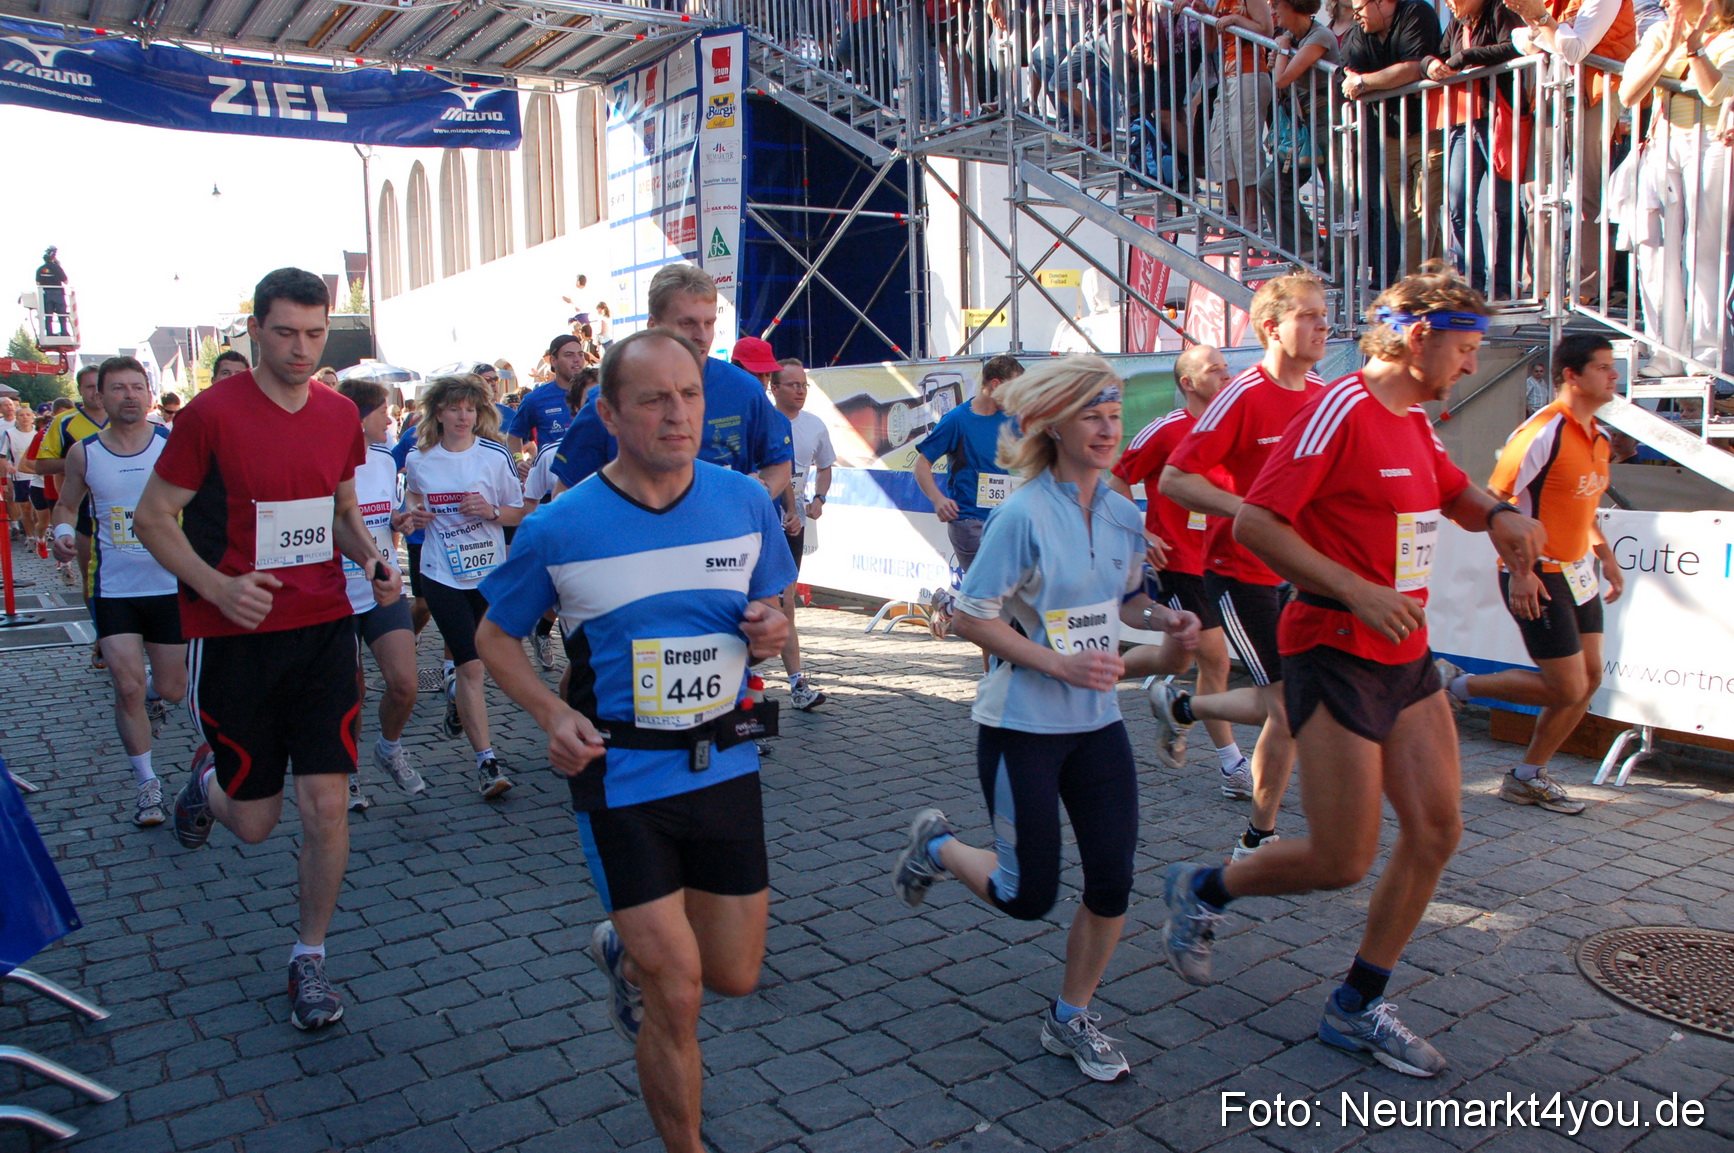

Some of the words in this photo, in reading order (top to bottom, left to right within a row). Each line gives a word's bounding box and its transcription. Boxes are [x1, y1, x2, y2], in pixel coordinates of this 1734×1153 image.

[208, 75, 348, 123] ZIEL
[989, 489, 1005, 500] 363
[280, 527, 326, 548] 3598
[459, 540, 493, 552] Rosmarie
[451, 557, 458, 565] C
[463, 552, 495, 569] 2067
[706, 558, 737, 567] swn
[1613, 536, 1699, 575] Gute
[1068, 613, 1107, 629] Sabine
[1055, 638, 1065, 650] C
[664, 647, 718, 665] Gregor
[641, 675, 654, 689] C
[667, 674, 721, 704] 446
